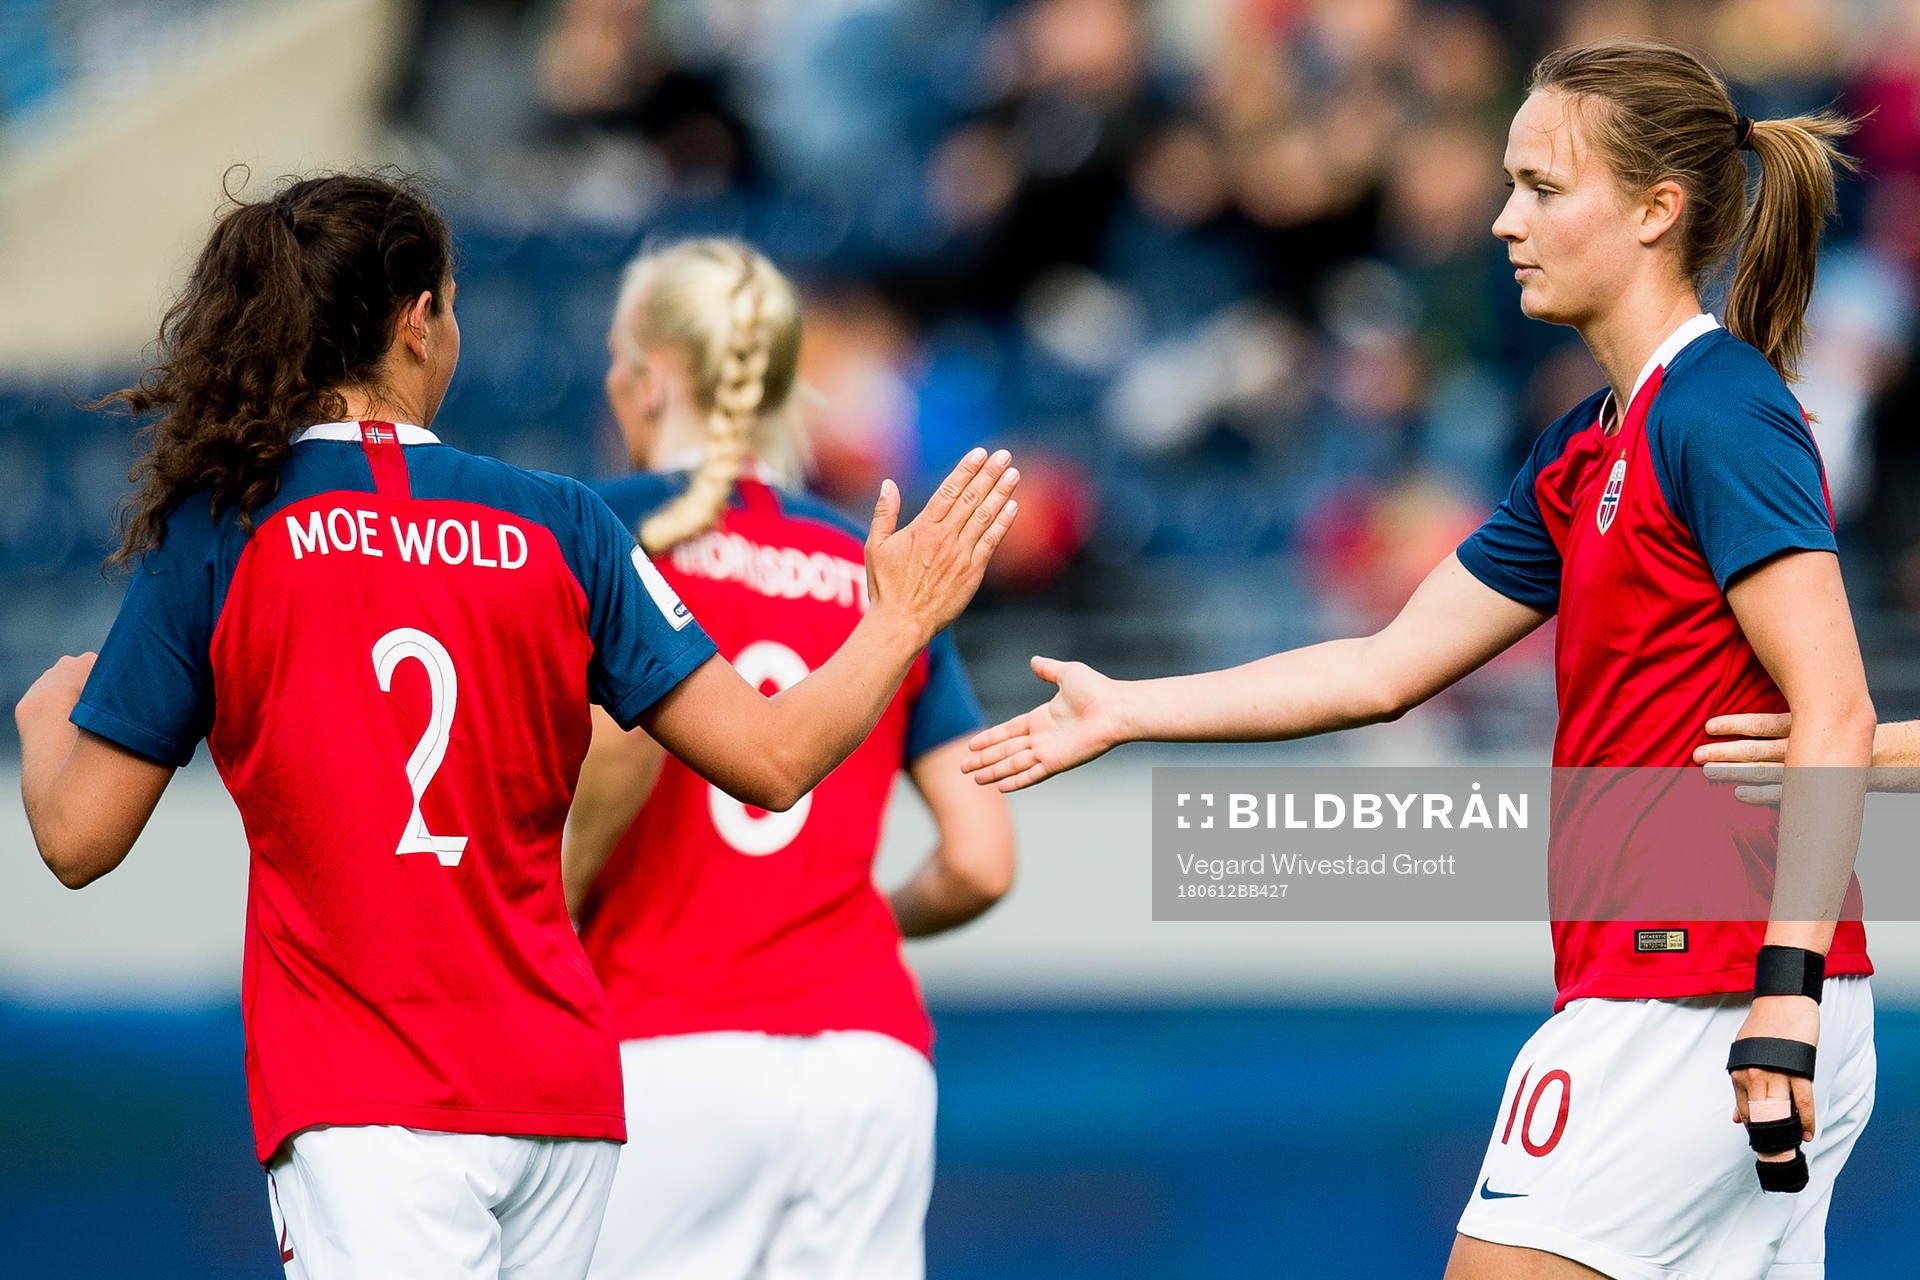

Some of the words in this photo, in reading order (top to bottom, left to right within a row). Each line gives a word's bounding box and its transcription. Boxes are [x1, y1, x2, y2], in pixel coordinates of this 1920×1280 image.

[286, 508, 383, 560] MOE
[390, 518, 528, 570] WOLD
[371, 627, 469, 867] 2
[1501, 1062, 1571, 1157] 10
